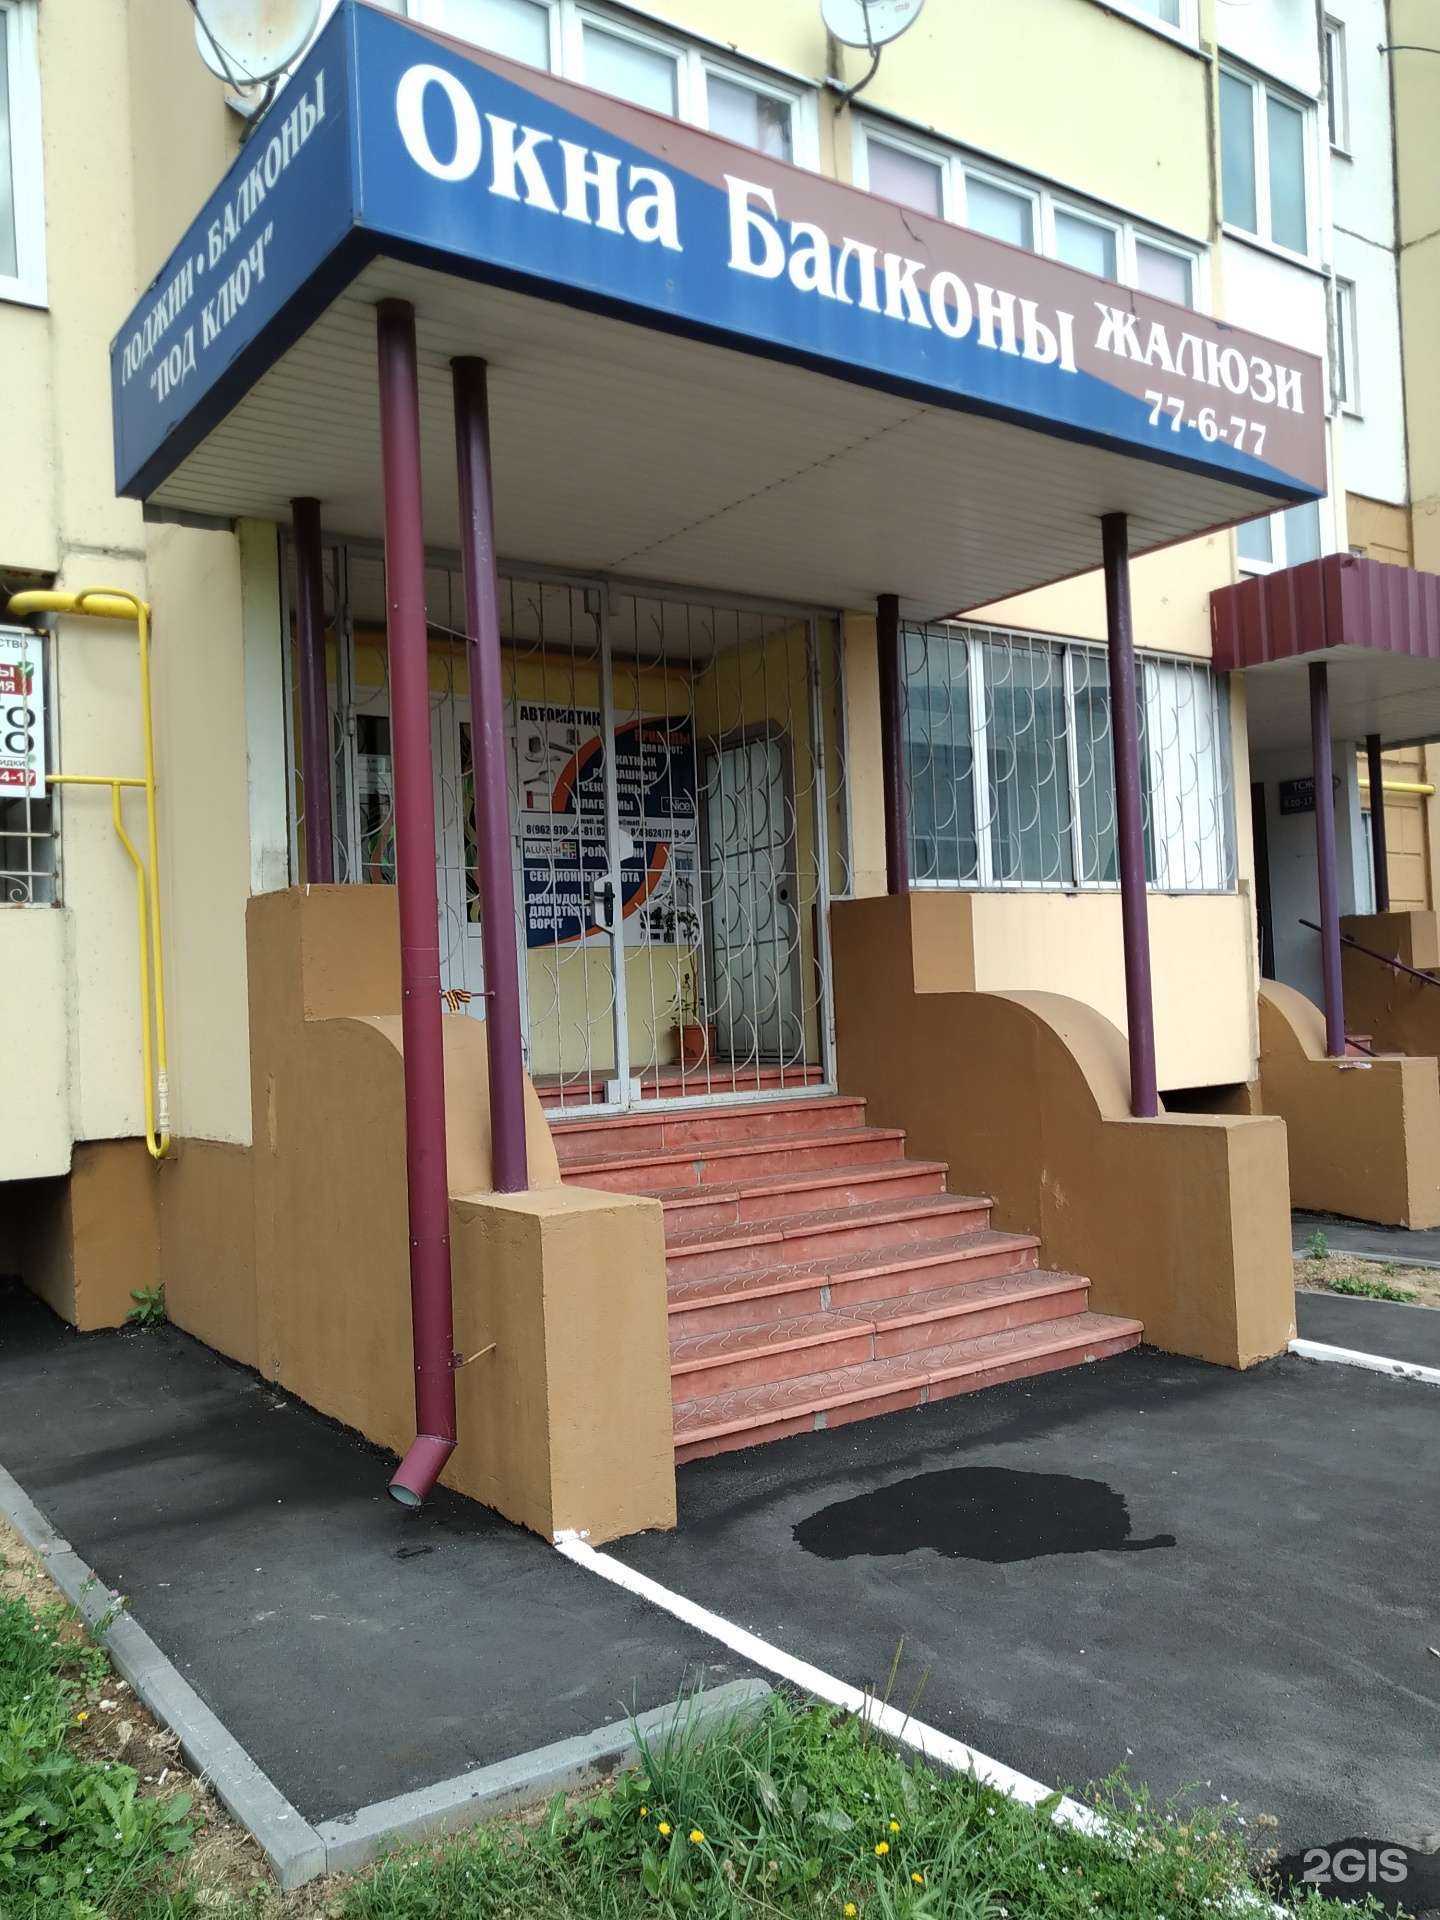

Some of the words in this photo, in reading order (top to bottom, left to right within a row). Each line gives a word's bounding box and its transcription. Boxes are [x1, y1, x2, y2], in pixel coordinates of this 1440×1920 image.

[207, 67, 326, 272] БАЛКОНЫ
[395, 63, 684, 253] Окна
[723, 173, 1079, 374] Балконы
[1093, 300, 1305, 415] ЖАЛЮЗИ
[1143, 389, 1268, 457] 77-6-77
[519, 705, 601, 727] АВТОМАТИК
